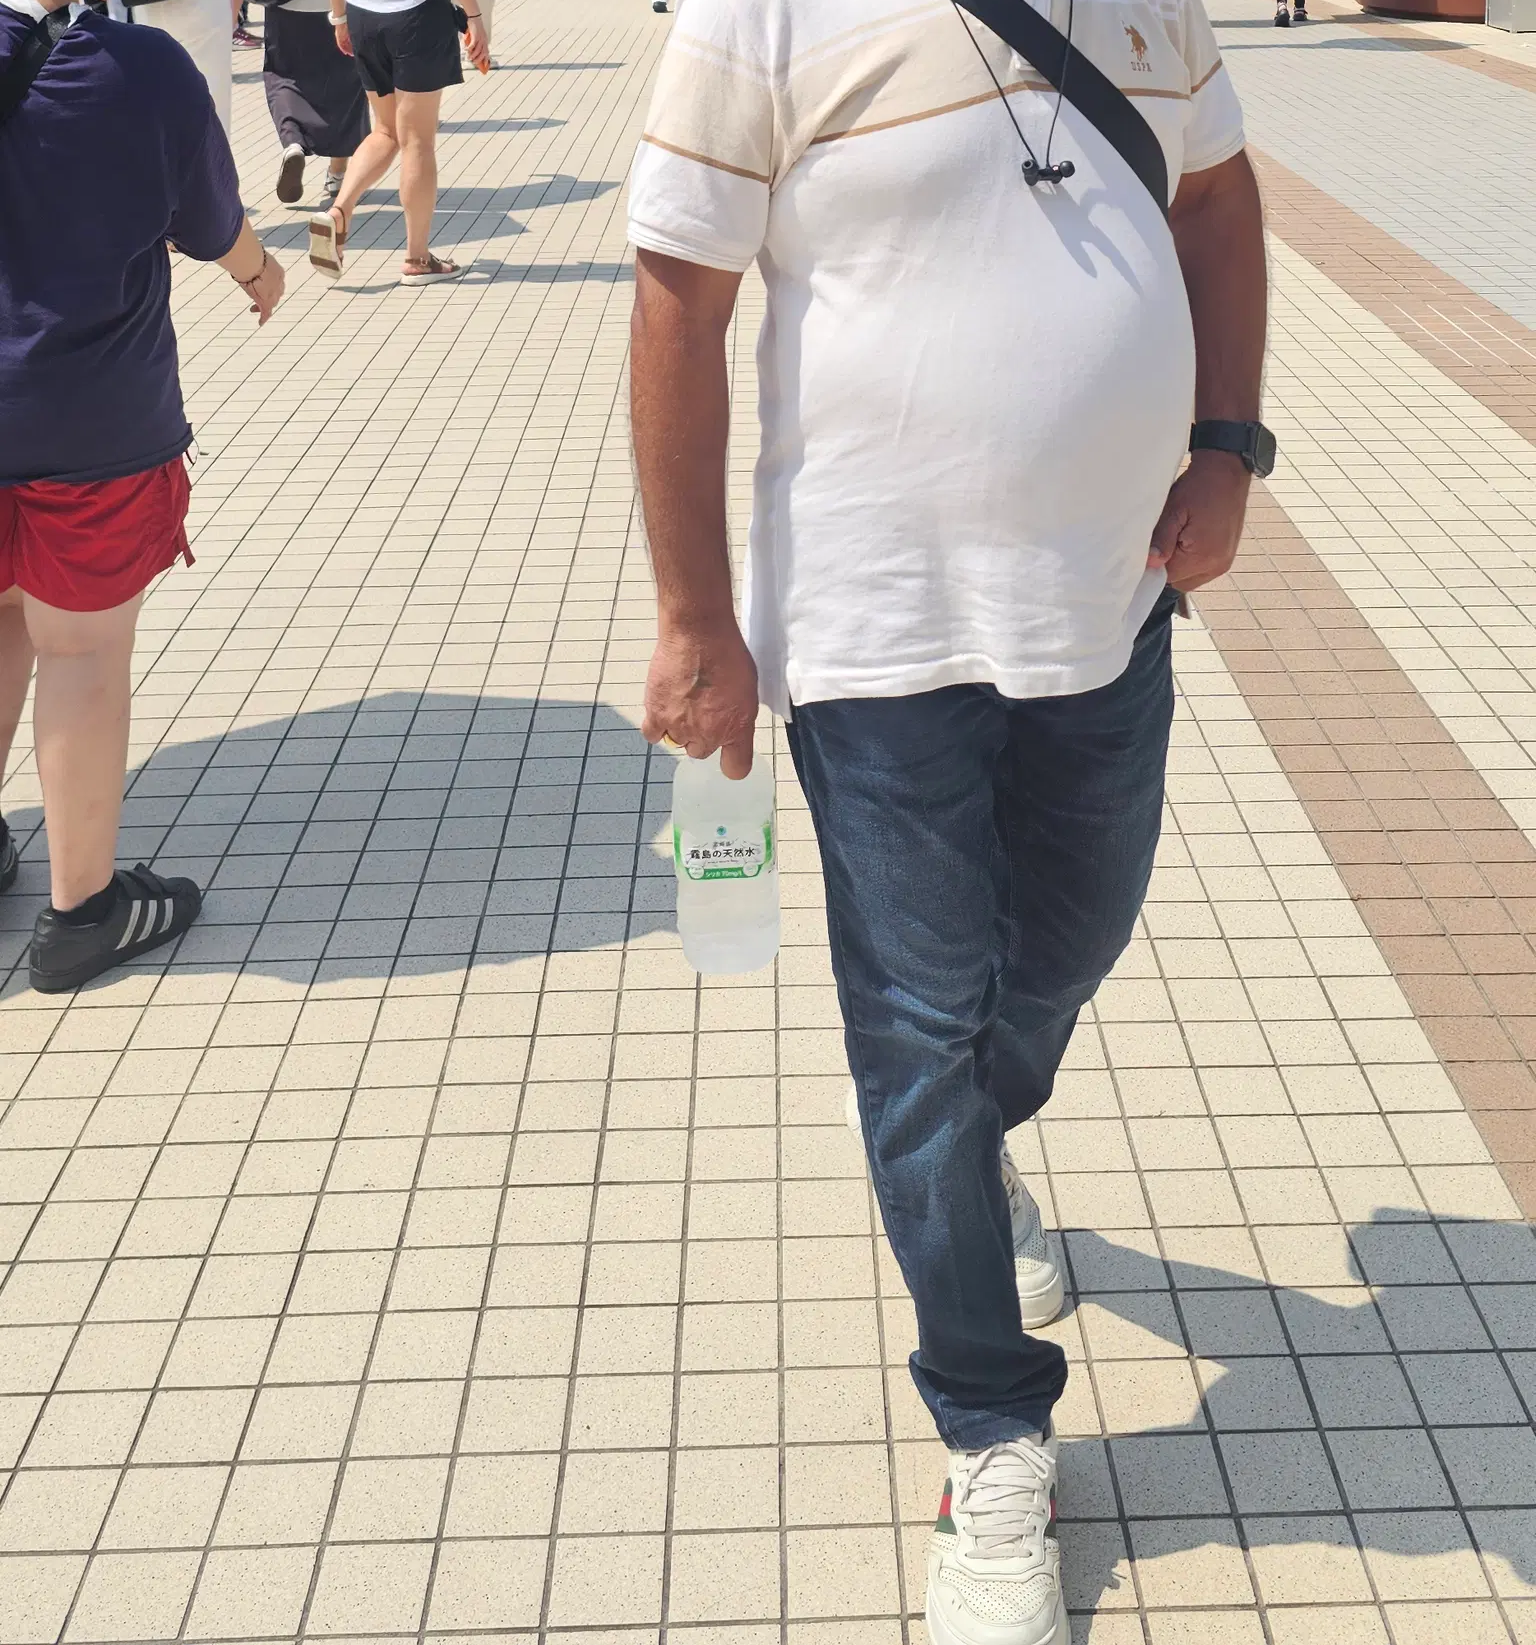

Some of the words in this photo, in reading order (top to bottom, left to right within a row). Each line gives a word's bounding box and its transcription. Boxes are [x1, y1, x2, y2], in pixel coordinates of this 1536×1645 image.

[690, 846, 755, 859] 霧島の天然水
